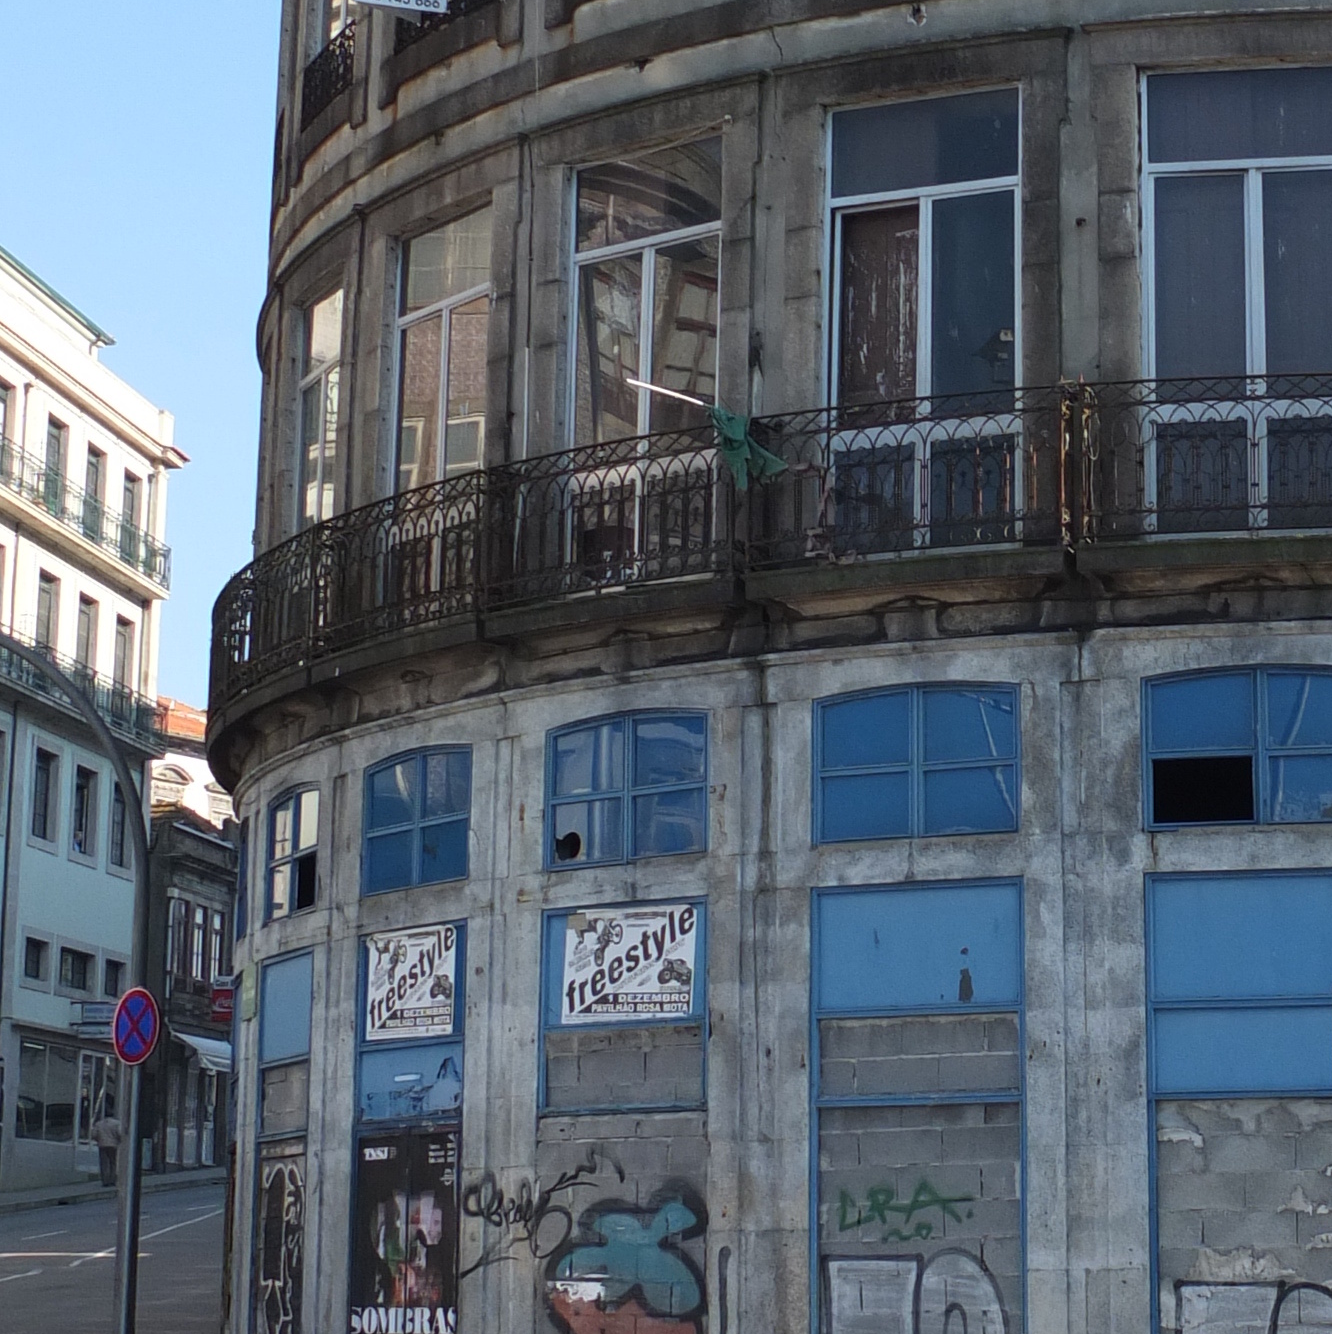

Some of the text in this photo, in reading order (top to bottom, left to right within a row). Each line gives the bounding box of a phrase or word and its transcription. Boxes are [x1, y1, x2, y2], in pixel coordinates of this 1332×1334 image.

[369, 927, 455, 1031] freestyle
[566, 907, 695, 1014] freestyle
[591, 1002, 635, 1013] PAVILHÃO
[636, 1003, 661, 1012] ROSA
[617, 993, 690, 1003] DEZEMBRO
